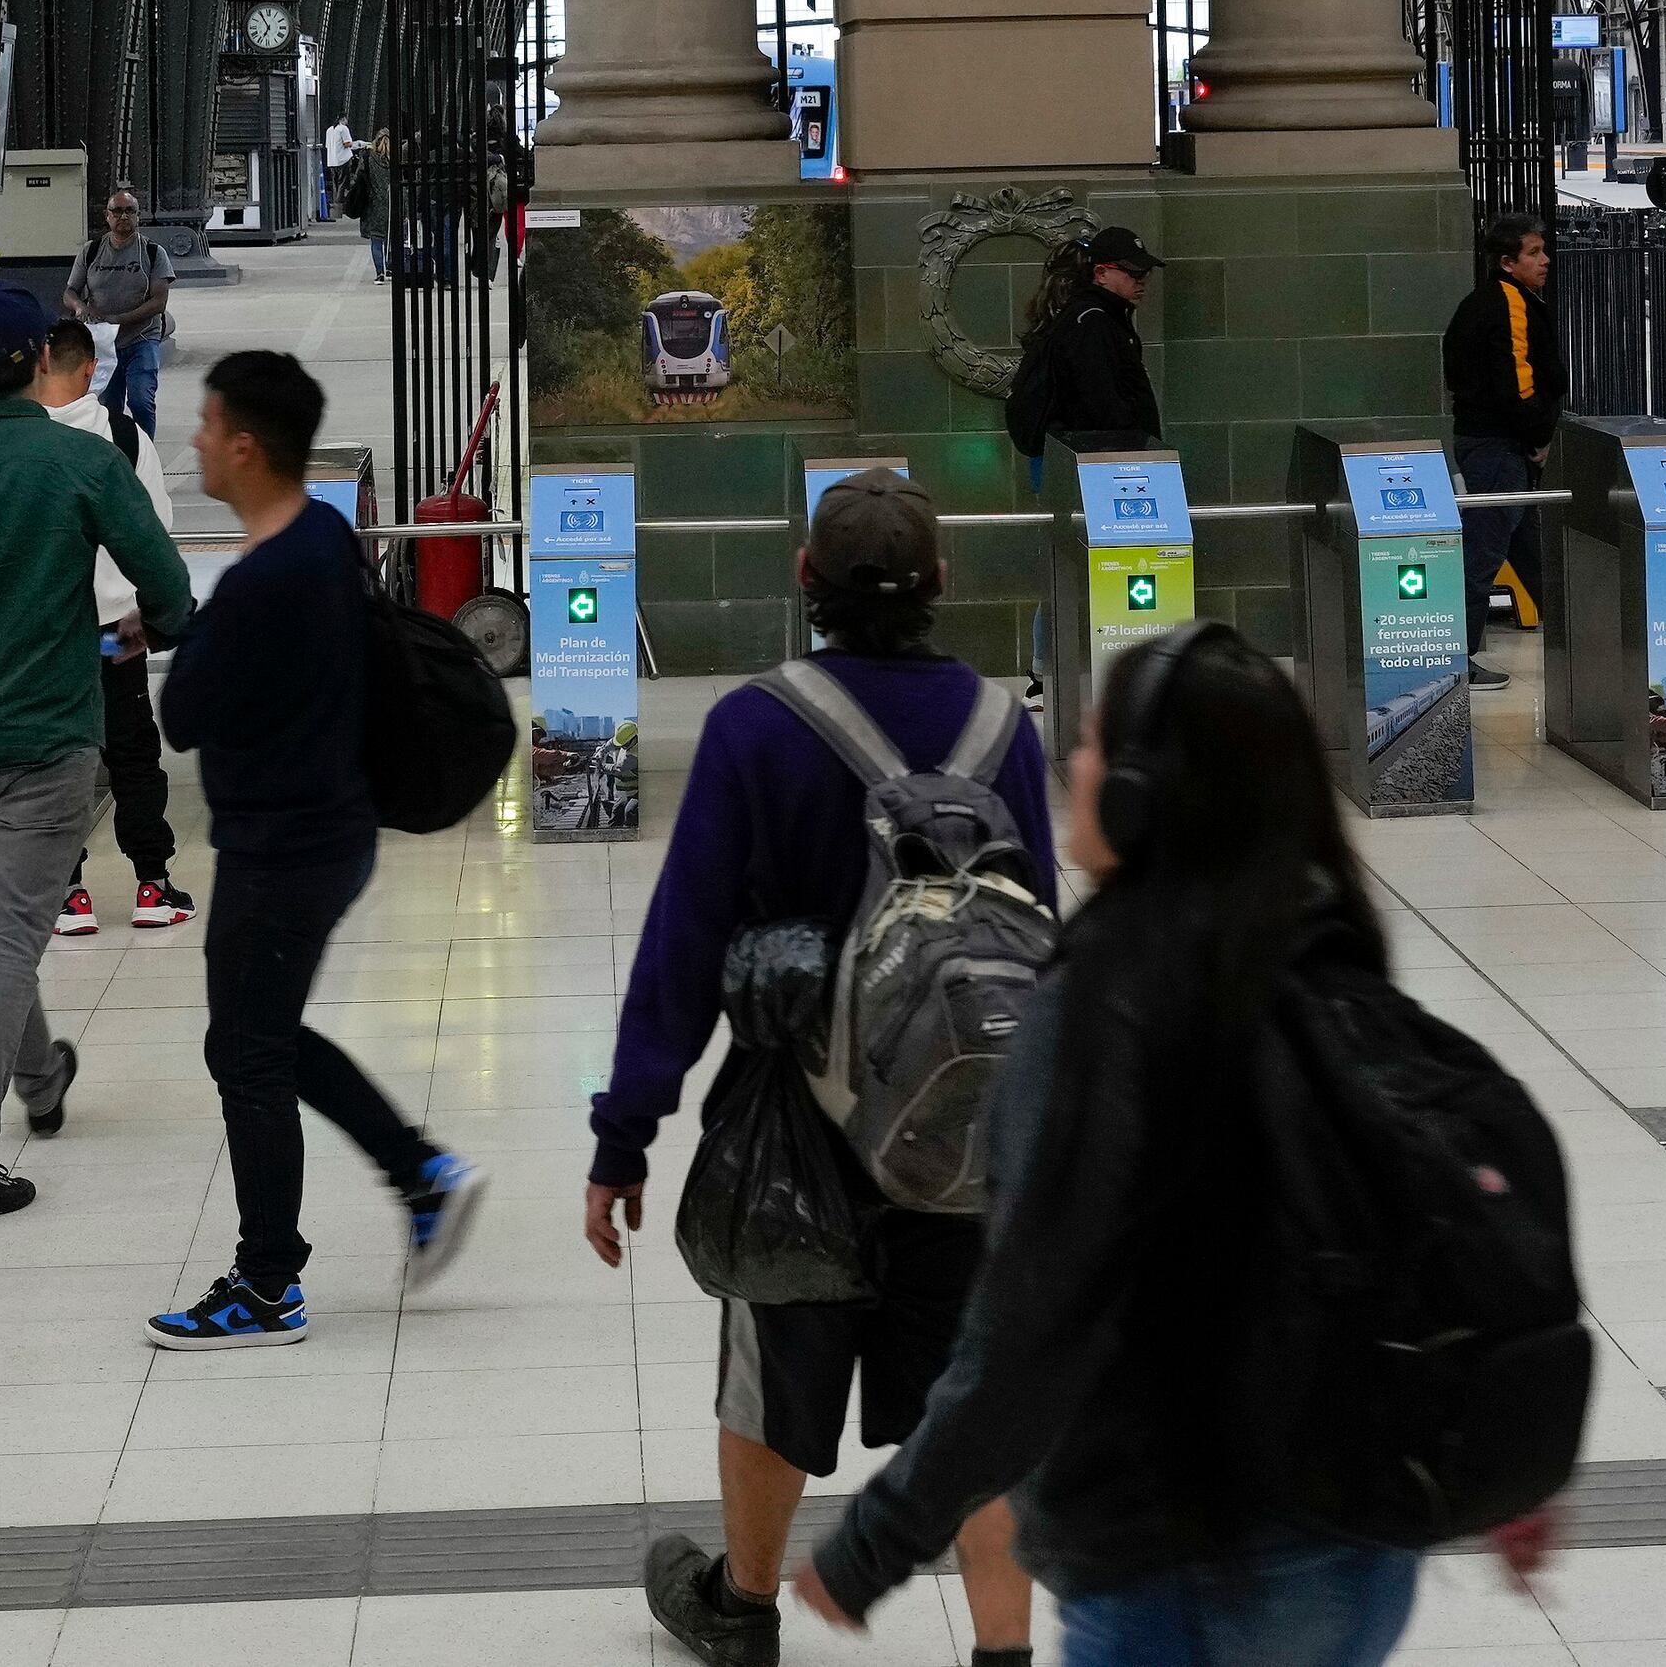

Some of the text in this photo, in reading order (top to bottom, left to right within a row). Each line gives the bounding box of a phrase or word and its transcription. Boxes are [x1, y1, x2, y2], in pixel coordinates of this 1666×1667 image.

[800, 96, 817, 104] M21
[1399, 613, 1454, 624] servicios
[1378, 627, 1451, 639] ferroviarios
[560, 637, 606, 648] Plan de
[1370, 641, 1460, 654] reactivados en
[537, 651, 630, 662] Modernización
[1380, 655, 1451, 668] todo el país
[538, 666, 629, 679] del Transporte
